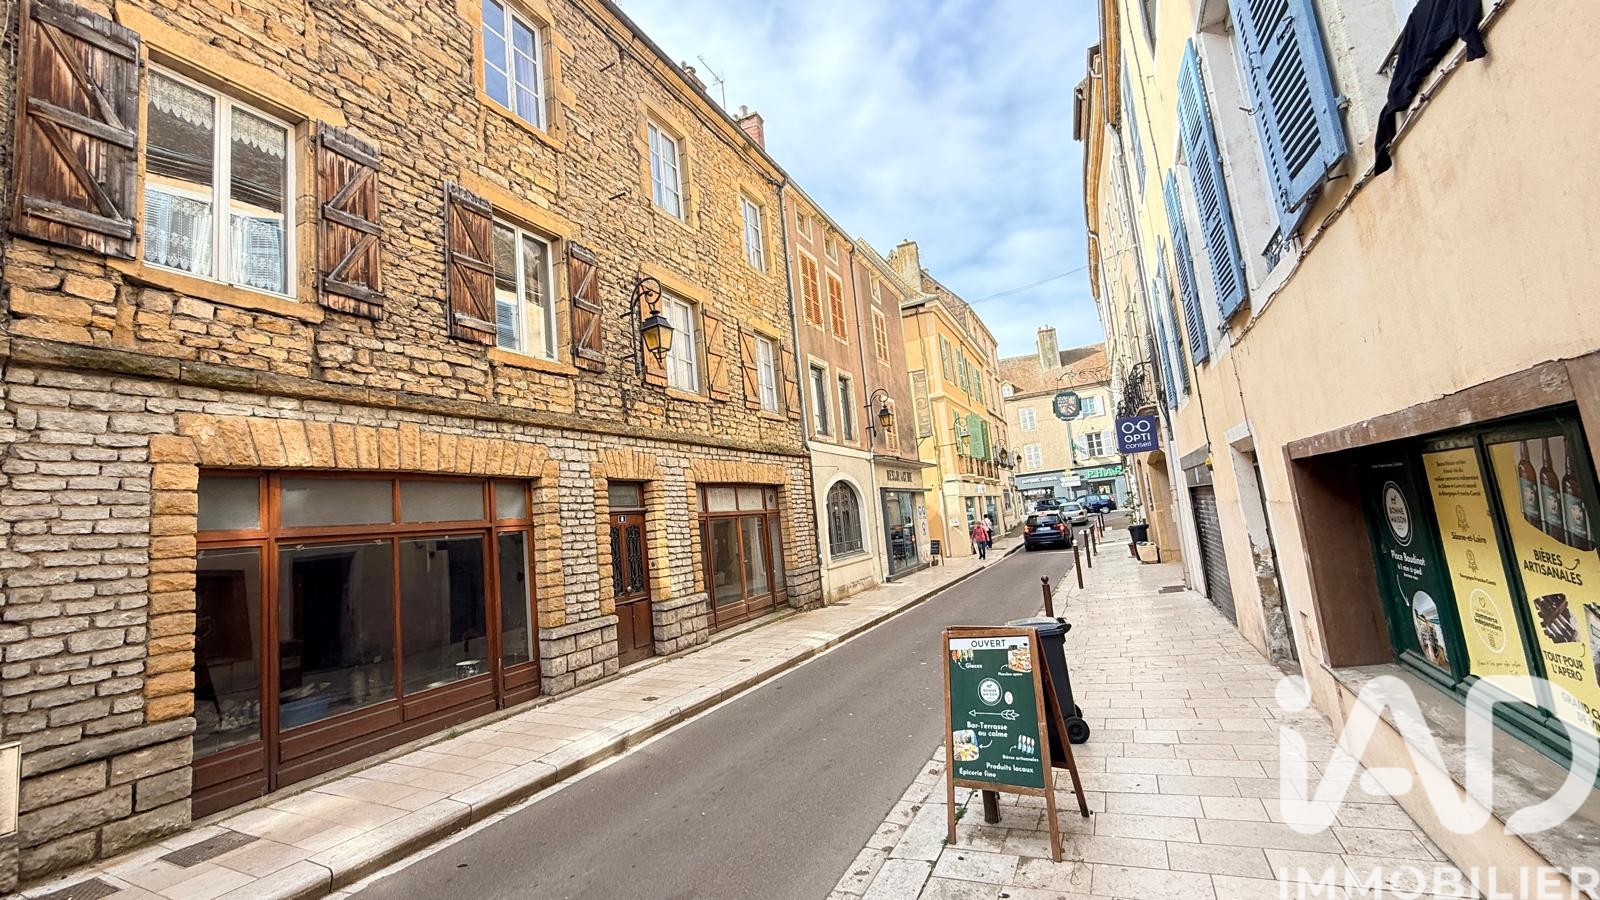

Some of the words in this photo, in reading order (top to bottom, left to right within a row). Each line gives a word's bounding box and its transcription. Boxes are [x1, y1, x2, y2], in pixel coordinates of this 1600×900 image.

[1124, 432, 1151, 443] OPTI
[1125, 440, 1152, 449] conseil
[1390, 549, 1403, 561] Place
[1533, 547, 1563, 567] BIÈRES
[1523, 560, 1583, 586] ARTISANALES
[971, 639, 1006, 648] OUVERT
[1543, 650, 1562, 663] TOUT
[1562, 655, 1585, 671] POUR
[967, 721, 1008, 730] Bar-Terrasse
[959, 766, 982, 776] Épicerie
[984, 770, 997, 778] fine
[986, 762, 1012, 771] Produits
[1012, 764, 1034, 773] locaux
